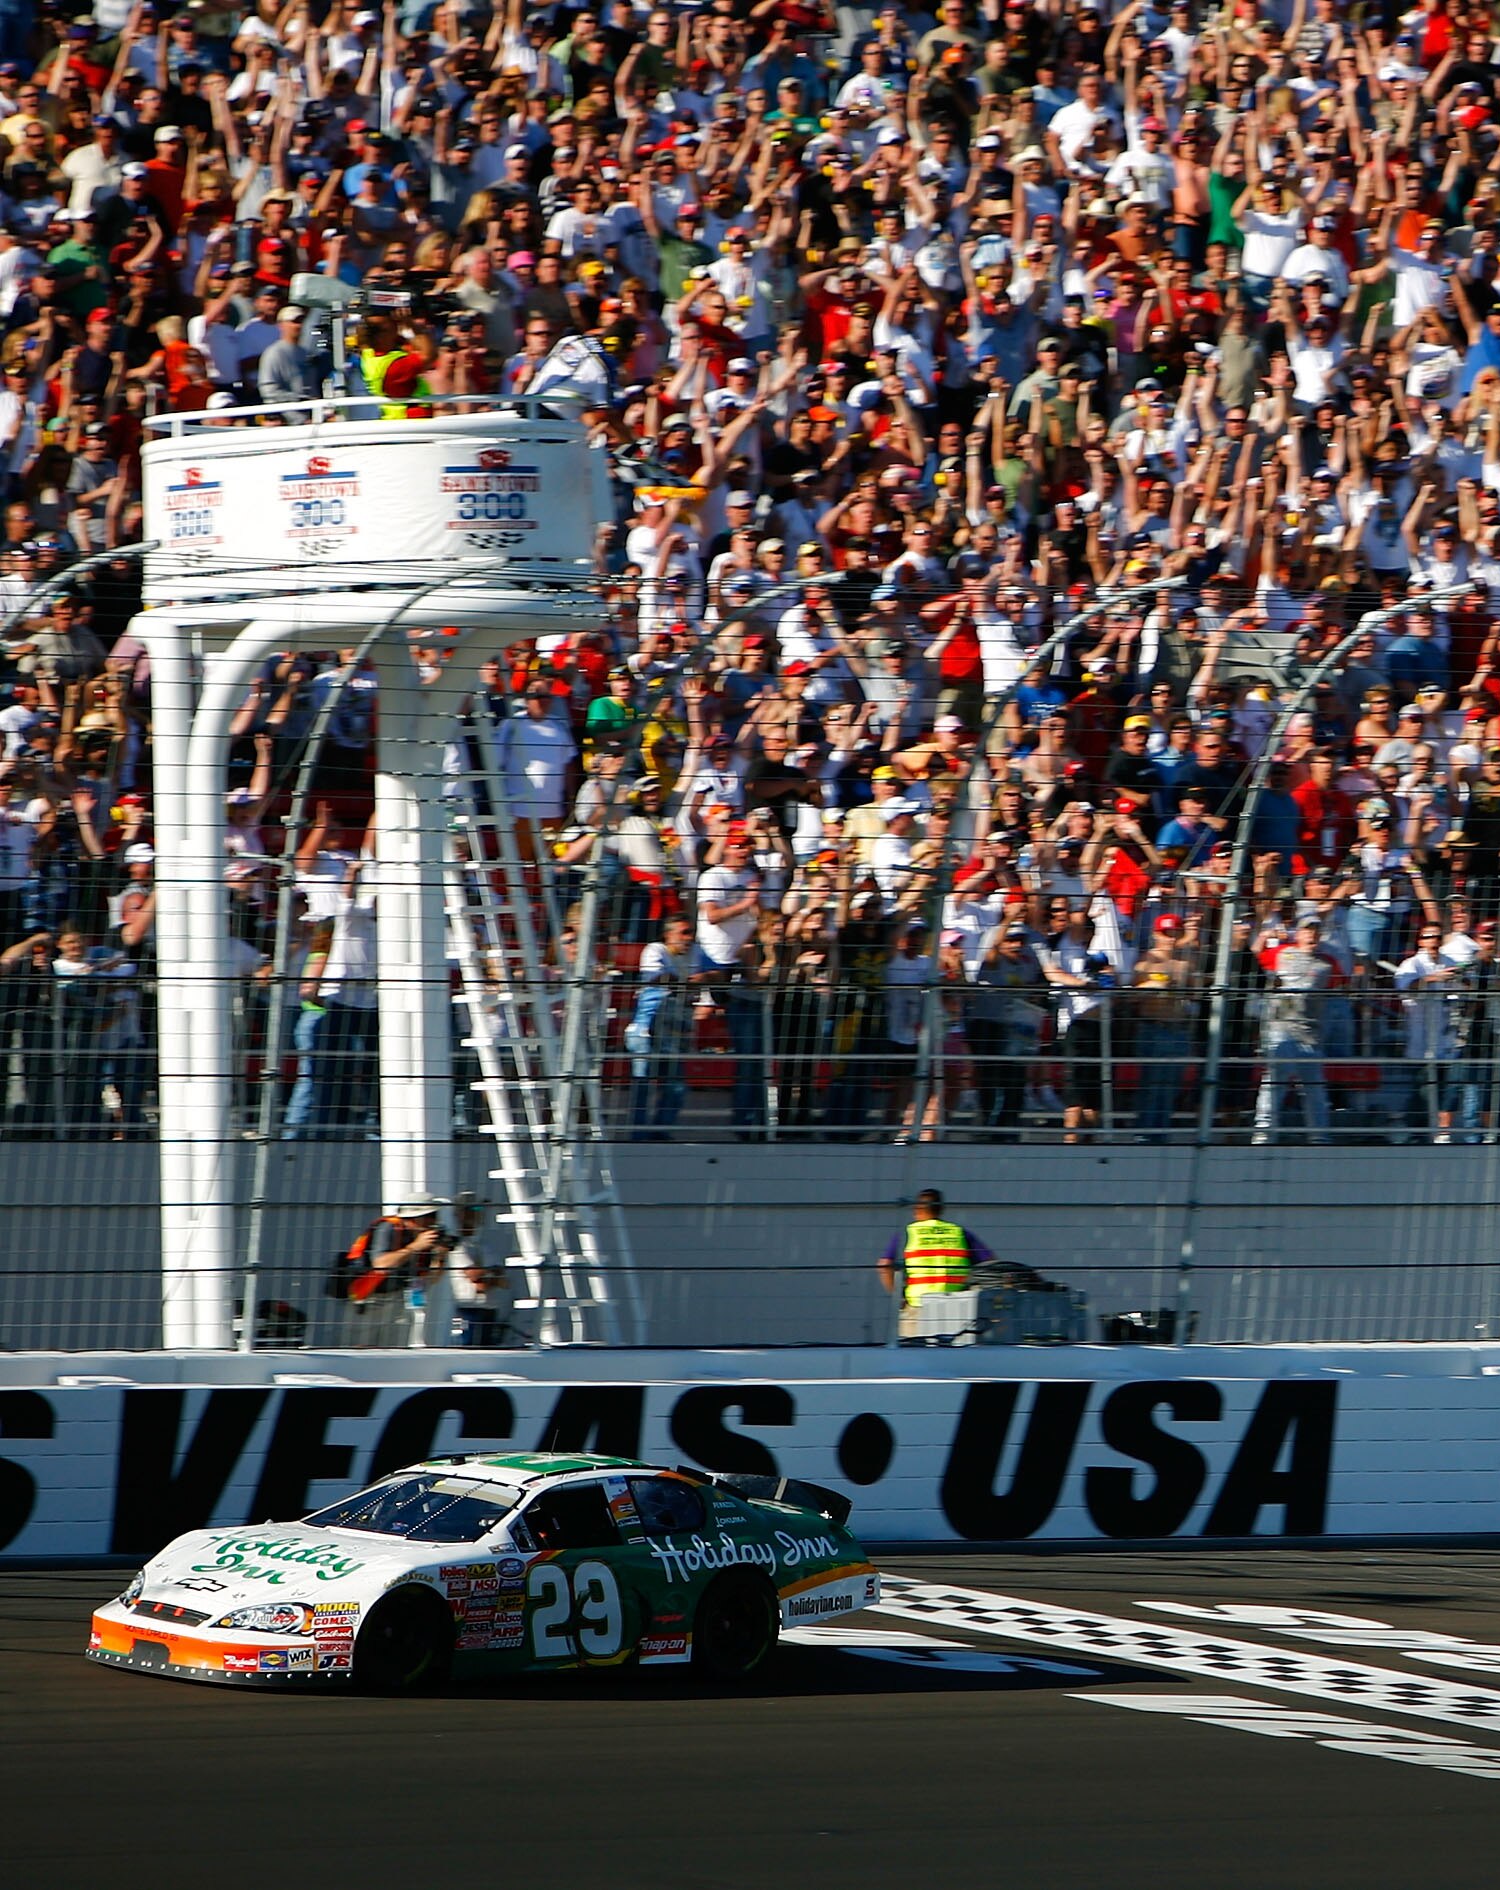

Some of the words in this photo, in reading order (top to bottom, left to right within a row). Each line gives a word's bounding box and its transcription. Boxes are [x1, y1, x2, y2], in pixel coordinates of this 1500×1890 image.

[455, 492, 528, 520] 300
[941, 1380, 1339, 1538] USA
[191, 1554, 286, 1584] Inn
[210, 1530, 365, 1580] Holiday
[650, 1533, 777, 1583] Holiday
[775, 1530, 839, 1567] Inn
[474, 1579, 498, 1590] MSD
[314, 1602, 359, 1612] MOOG
[528, 1560, 623, 1658] 29
[789, 1595, 852, 1616] holidayinn.com
[314, 1616, 347, 1625] COMP
[289, 1649, 311, 1662] WIX
